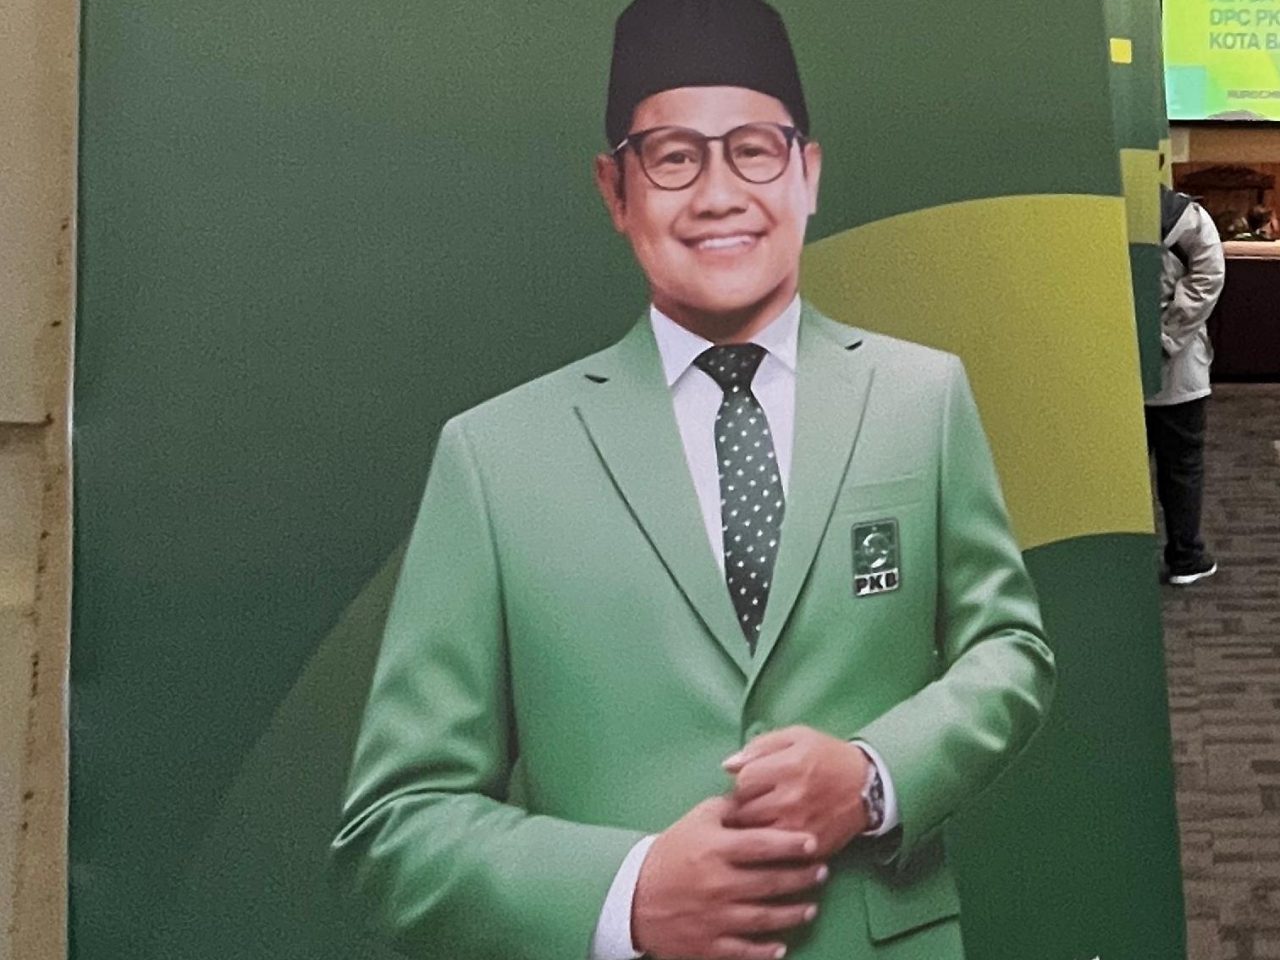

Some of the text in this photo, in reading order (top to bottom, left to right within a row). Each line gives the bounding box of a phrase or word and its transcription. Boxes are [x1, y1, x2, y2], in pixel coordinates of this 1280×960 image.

[1209, 8, 1251, 26] DPC
[1209, 32, 1260, 50] KOTA
[856, 572, 898, 593] PKB
